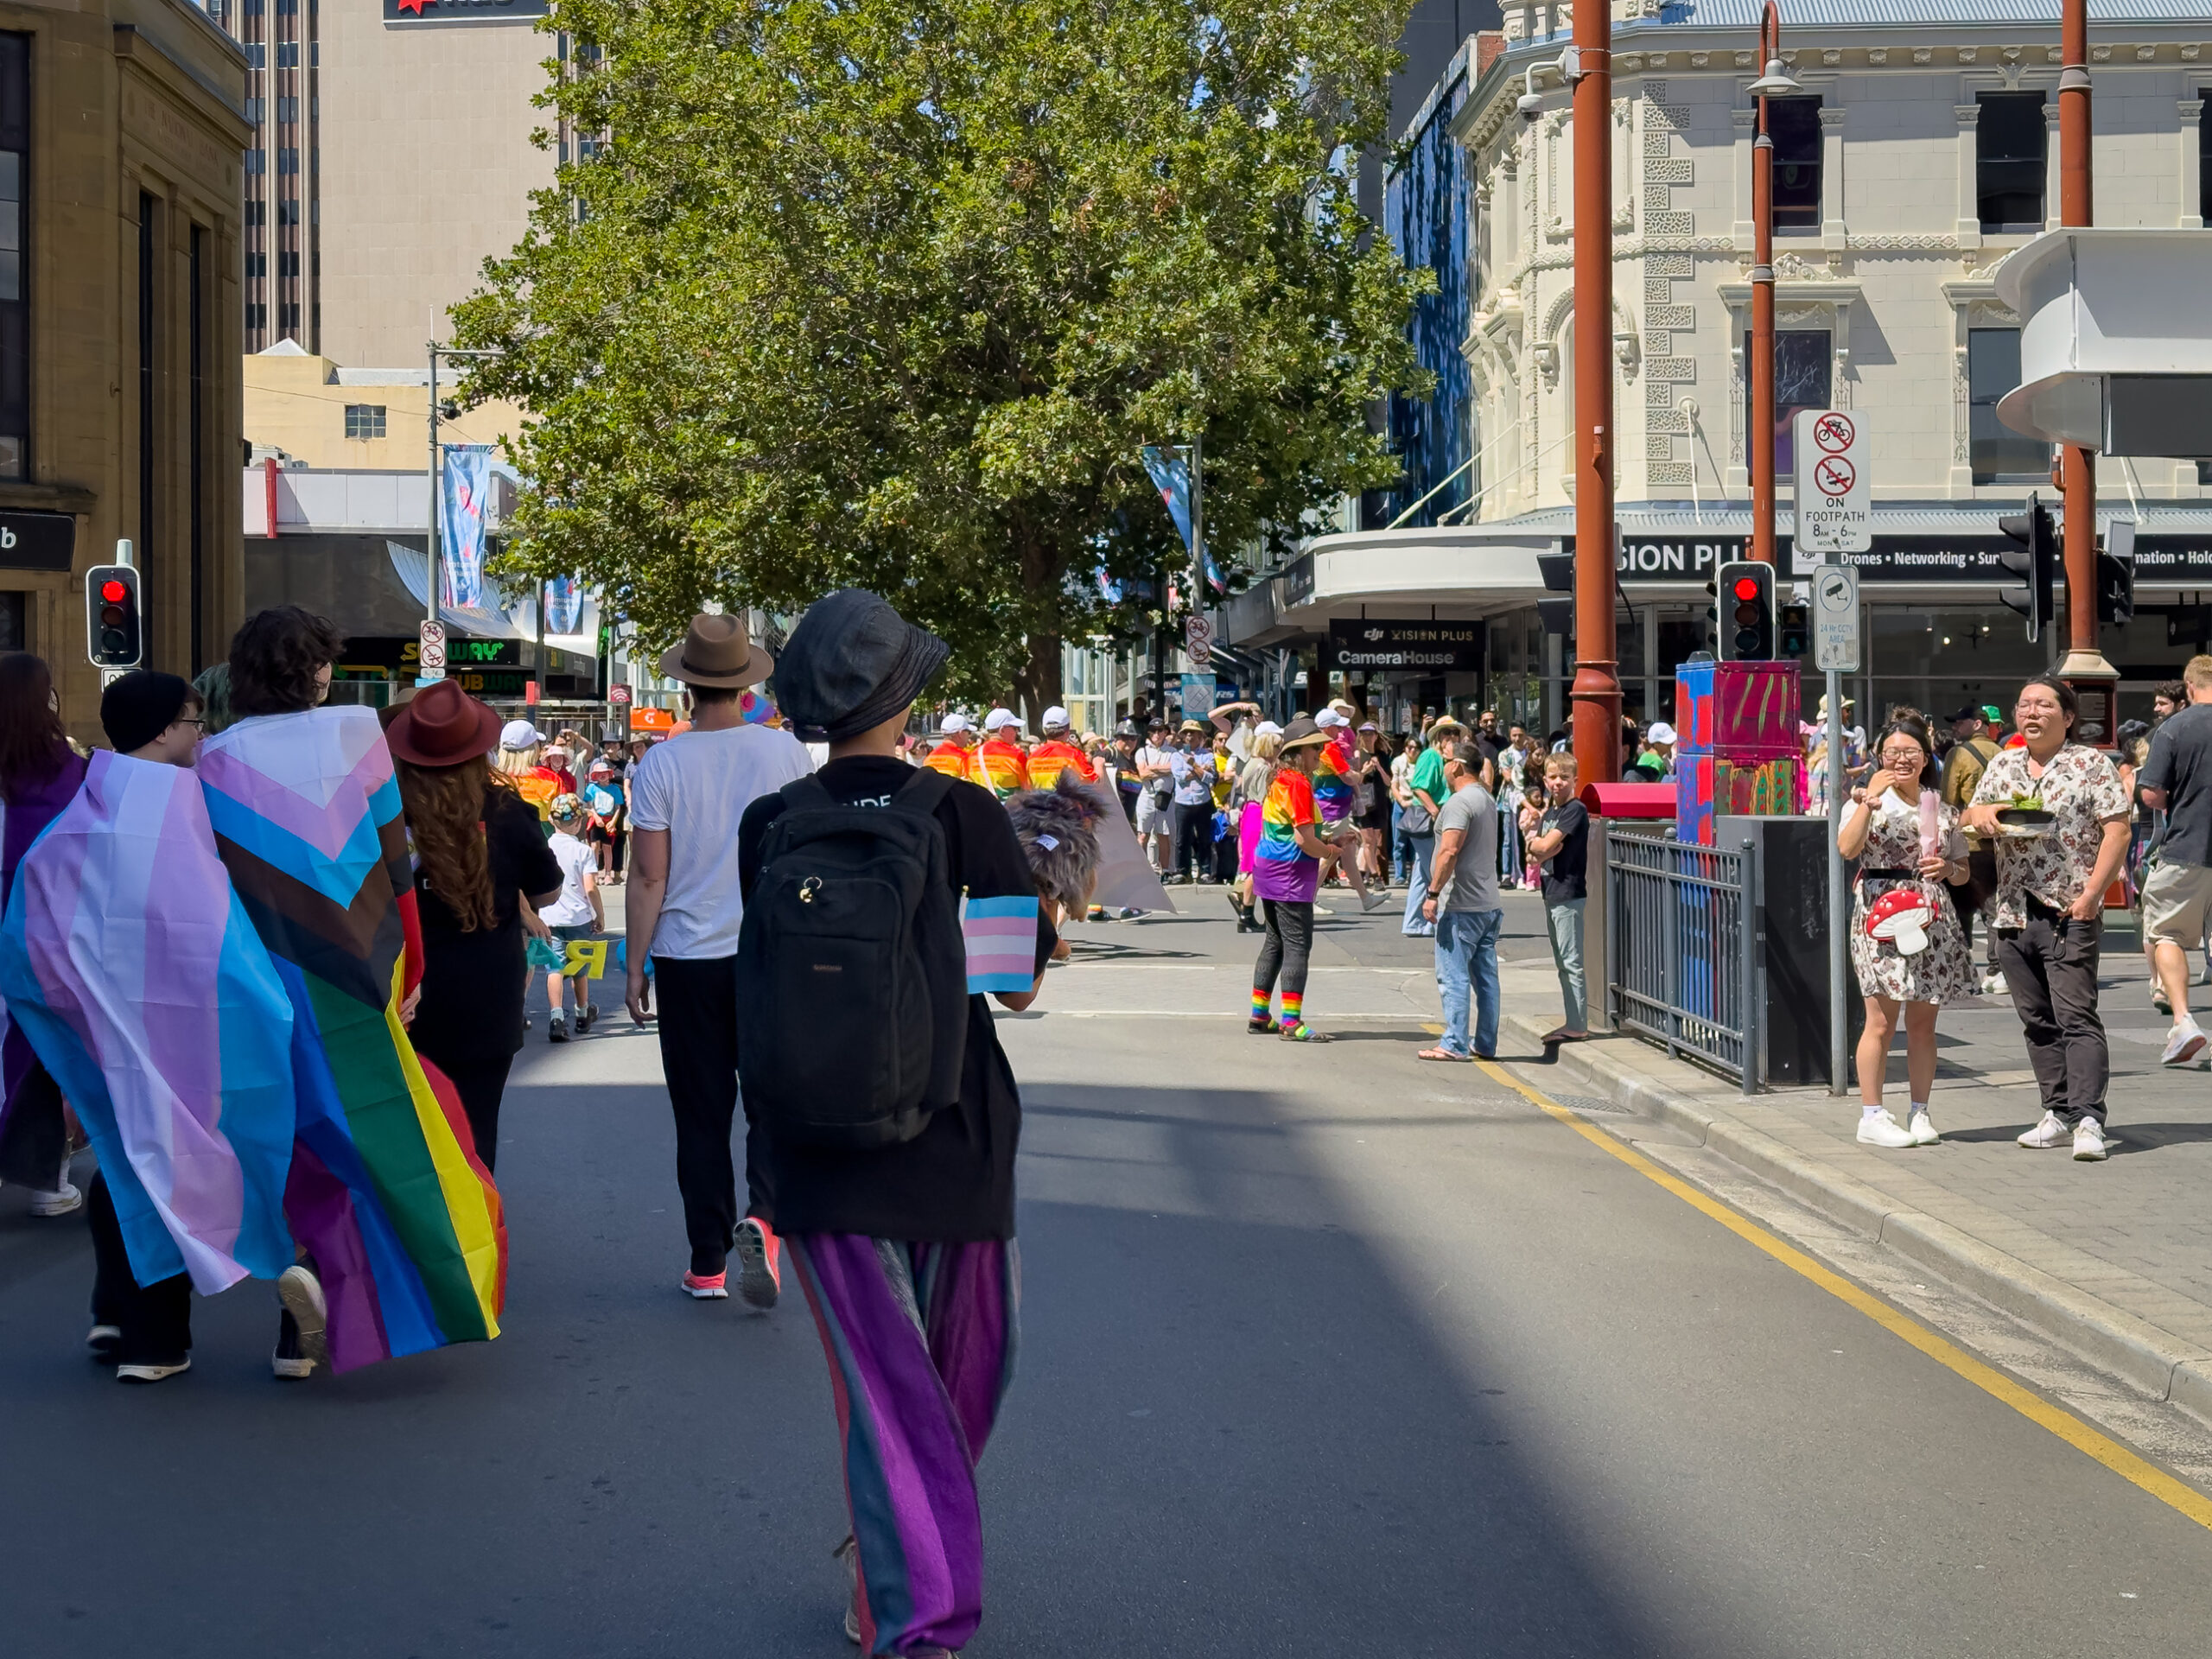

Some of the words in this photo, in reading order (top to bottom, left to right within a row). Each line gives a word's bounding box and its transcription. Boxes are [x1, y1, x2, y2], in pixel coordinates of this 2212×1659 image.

[1826, 497, 1845, 508] ON
[1805, 511, 1865, 522] FOOTPATH
[1840, 552, 1882, 564] Drones
[1895, 551, 1966, 568] Networking
[1978, 551, 1999, 564] Sur
[1820, 624, 1828, 632] 24
[1838, 624, 1853, 632] CCTV
[1441, 630, 1473, 641] PLUS
[1829, 635, 1846, 644] AREA
[400, 642, 505, 662] SWAY
